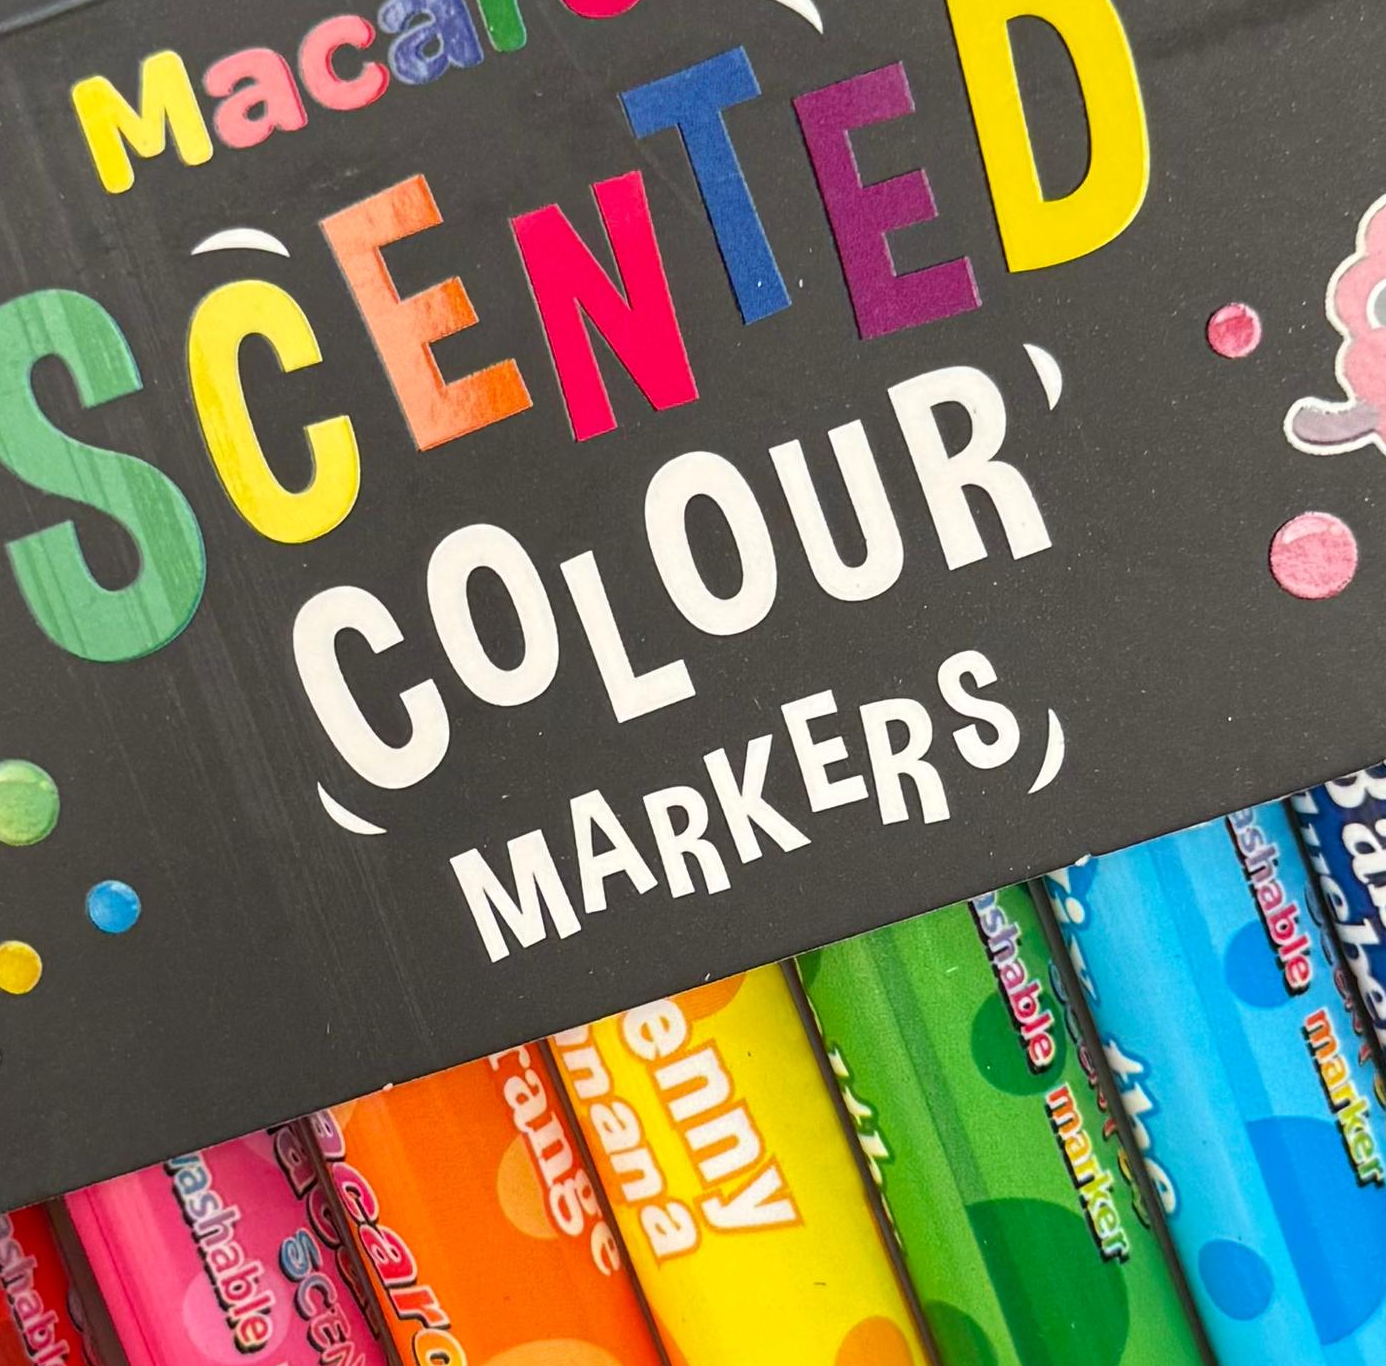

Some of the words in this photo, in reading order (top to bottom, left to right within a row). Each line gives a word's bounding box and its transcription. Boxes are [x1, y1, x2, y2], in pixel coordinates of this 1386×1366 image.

[292, 364, 1052, 789] COLOUR
[449, 649, 1019, 963] MARKERS
[551, 1023, 700, 1263] nana
[620, 997, 802, 1232] enny
[967, 892, 1056, 1074] shable
[1043, 1081, 1130, 1264] marker
[1226, 806, 1312, 997] ashable
[1302, 1006, 1386, 1189] marker
[487, 1044, 622, 1277] range
